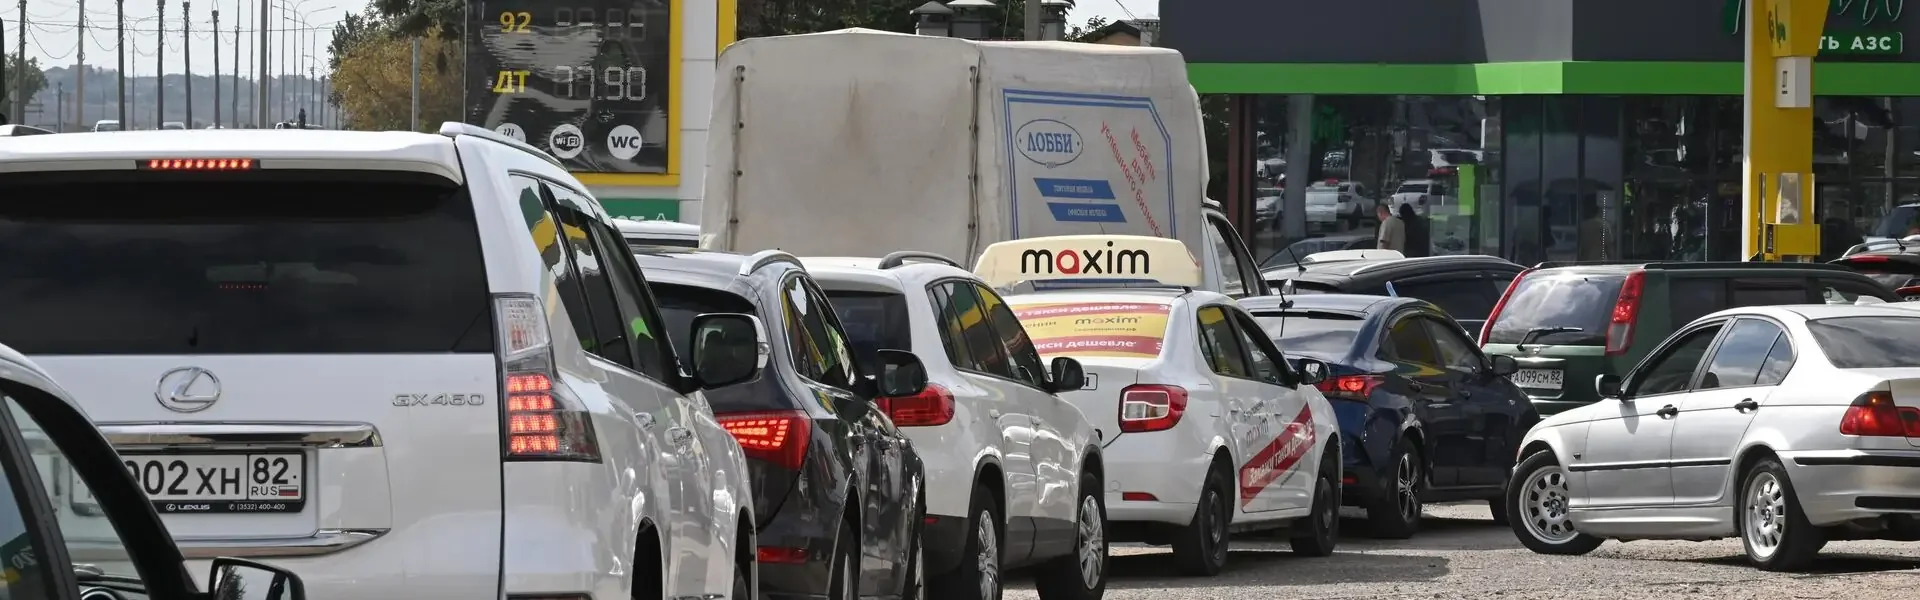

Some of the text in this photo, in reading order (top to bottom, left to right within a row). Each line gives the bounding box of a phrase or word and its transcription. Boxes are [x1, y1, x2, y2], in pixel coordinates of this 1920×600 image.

[500, 12, 531, 33] 92
[1818, 36, 1892, 50] ТЬ АЗС
[493, 71, 530, 94] ДТ
[611, 136, 640, 149] WC
[1026, 132, 1074, 154] ЛОББИ
[1021, 240, 1149, 275] maxim
[1075, 315, 1138, 325] maxim
[252, 457, 289, 485] 82
[251, 486, 278, 496] RUS
[237, 503, 257, 511] (3532)
[258, 503, 286, 511] 400-400
